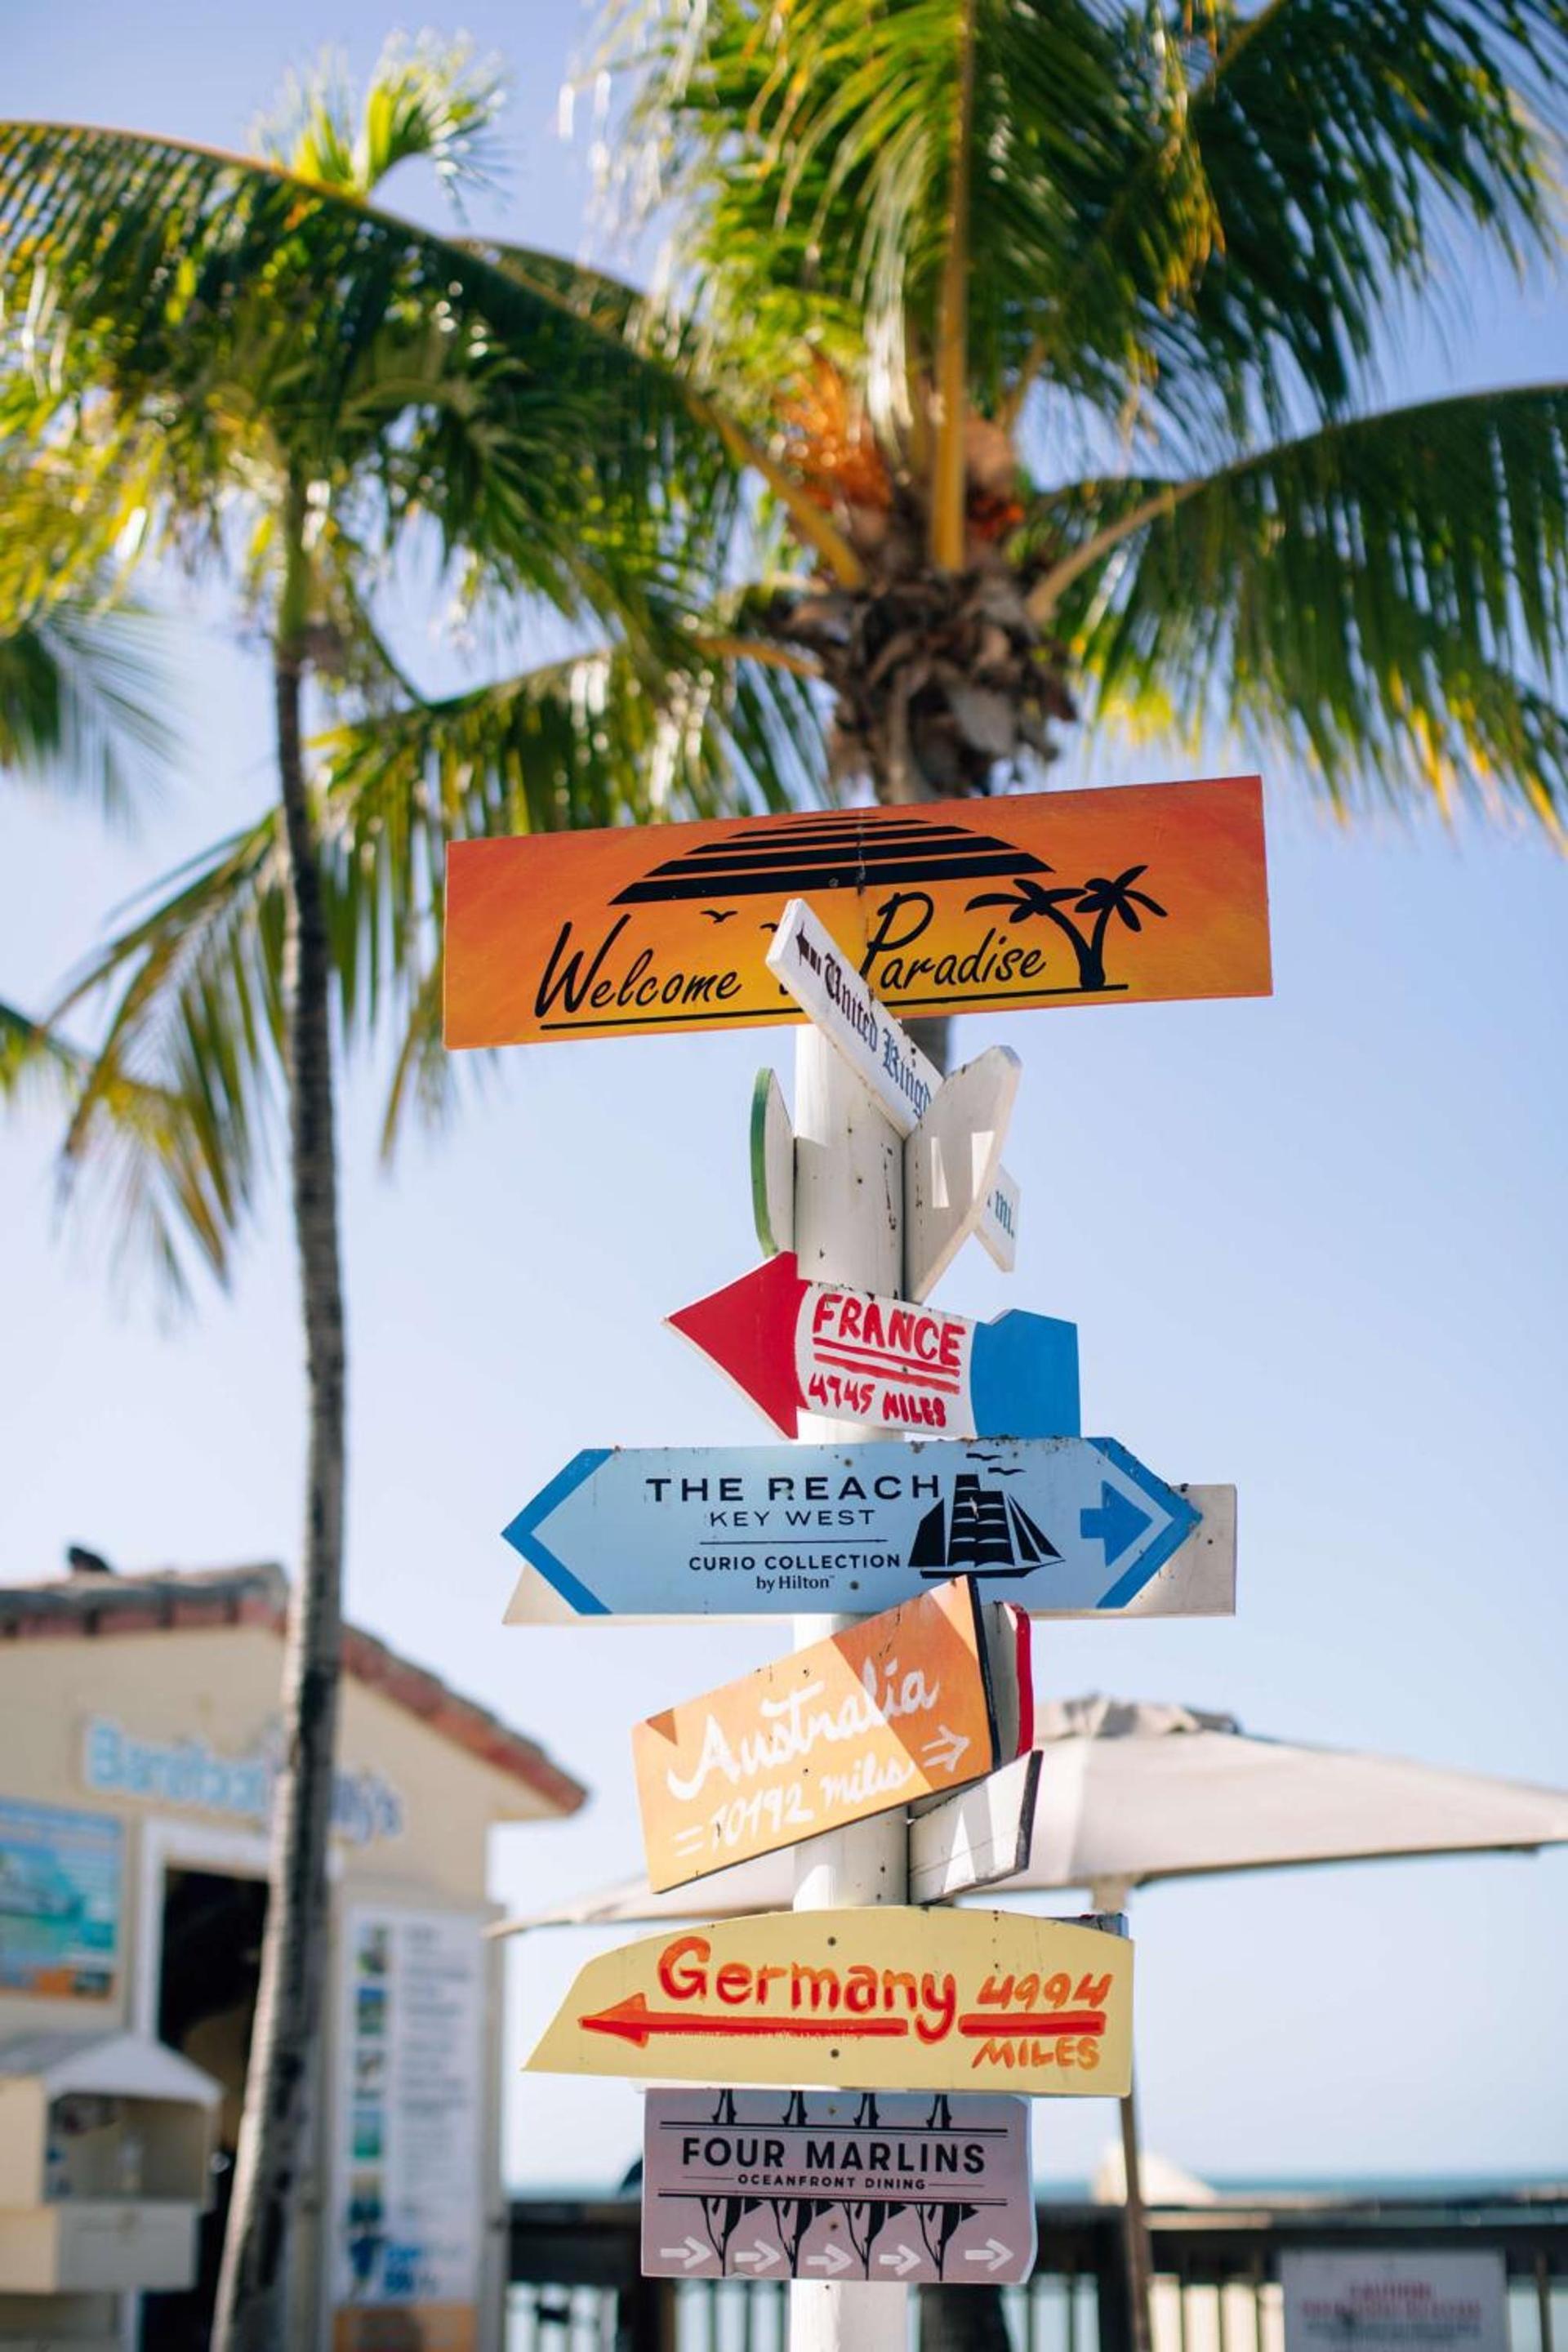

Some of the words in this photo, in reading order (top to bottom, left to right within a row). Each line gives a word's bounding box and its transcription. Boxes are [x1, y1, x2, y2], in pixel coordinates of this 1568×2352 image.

[535, 912, 742, 1018] Welcome
[859, 892, 1047, 990] Paradise
[825, 952, 879, 1053] United
[812, 1294, 966, 1367] FRANCE
[882, 1391, 947, 1428] MILES
[645, 1477, 744, 1502] THE
[768, 1474, 939, 1501] REACH
[710, 1511, 769, 1527] KEY
[785, 1508, 875, 1526] WEST
[688, 1555, 756, 1571] CURIO
[764, 1553, 901, 1570] COLLECTION
[756, 1575, 775, 1593] by
[667, 1656, 939, 1801] Australia
[818, 1752, 915, 1810] miles
[658, 1936, 957, 2045] Germany
[975, 1971, 1115, 2011] 4994
[972, 2036, 1102, 2069] MILES
[681, 2136, 786, 2169] FOUR
[805, 2138, 986, 2175] MARLINS
[737, 2172, 856, 2189] OCEANFRONT
[864, 2176, 927, 2191] DINING
